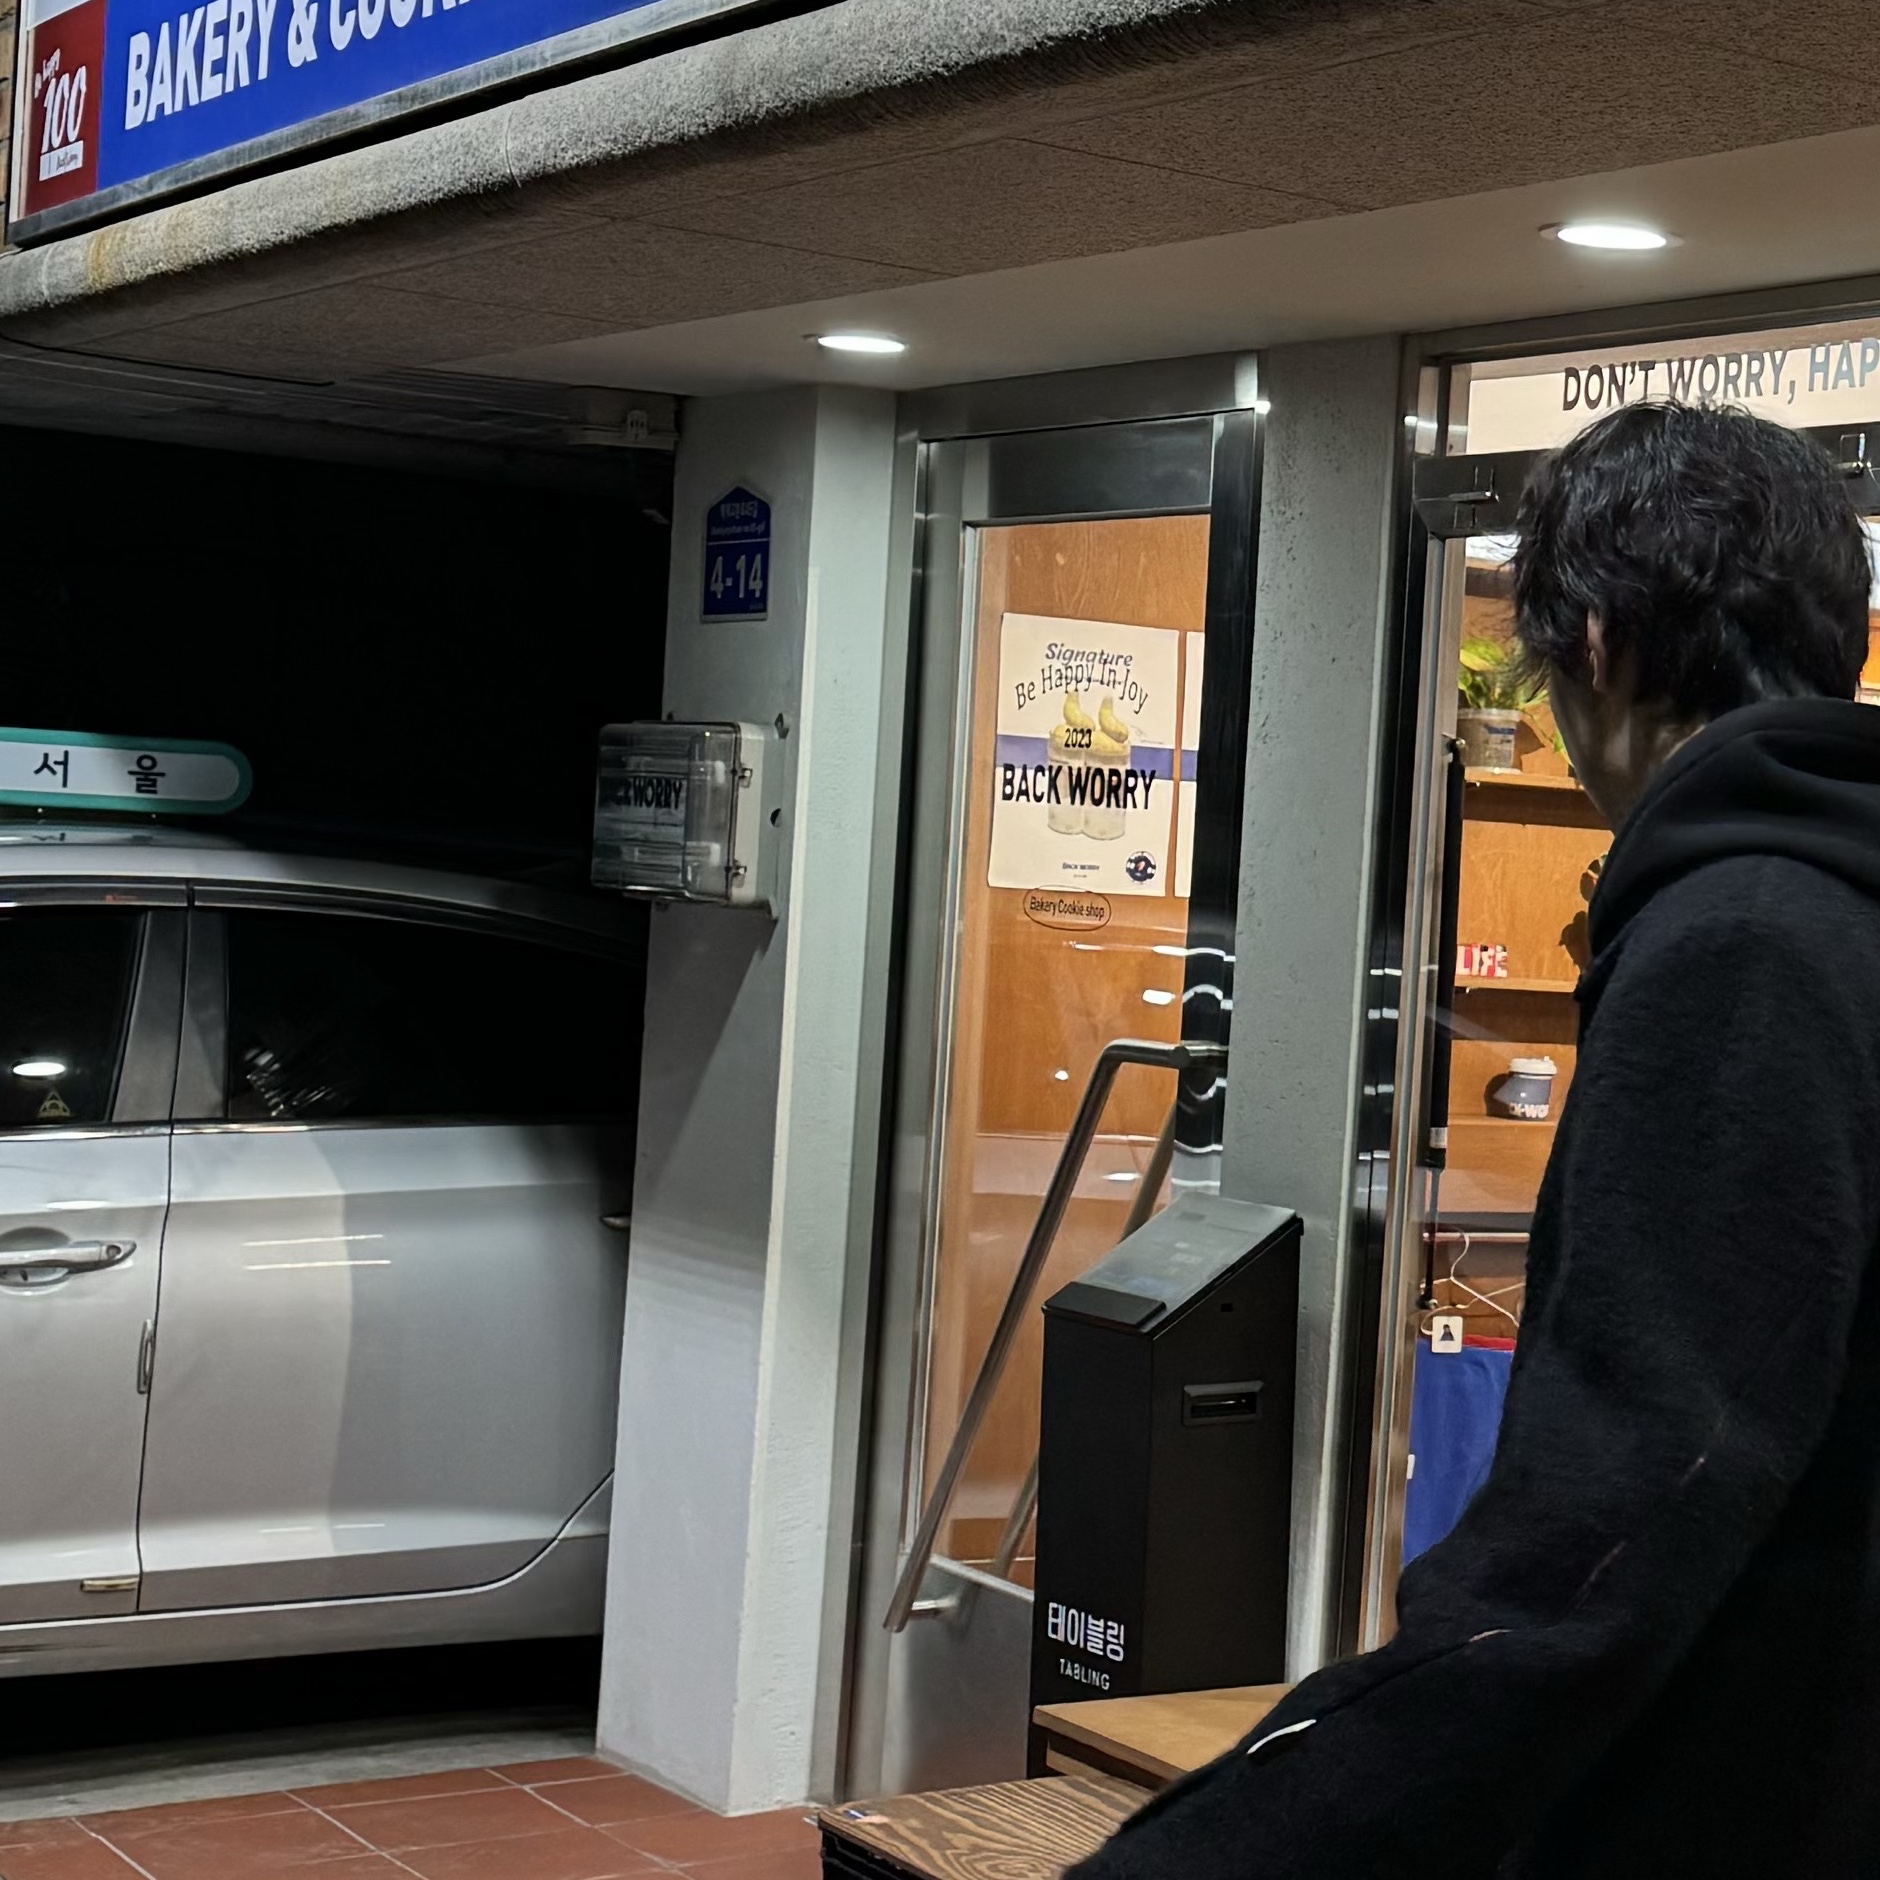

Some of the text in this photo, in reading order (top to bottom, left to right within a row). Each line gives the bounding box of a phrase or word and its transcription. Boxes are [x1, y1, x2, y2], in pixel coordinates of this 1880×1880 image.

[125, 0, 275, 130] BAKERY
[287, 0, 319, 68] &
[1563, 359, 1656, 412] DON'T
[1666, 349, 1797, 406] WORRY,
[710, 553, 763, 599] 4-14
[1045, 642, 1133, 667] Signature
[1015, 681, 1036, 710] Be
[1064, 727, 1092, 749] 2023
[33, 750, 166, 795] 서울
[1001, 763, 1156, 811] BACK WORRY
[1058, 899, 1085, 917] Cookie
[1085, 902, 1105, 921] shop
[1456, 944, 1508, 978] LIFE
[1047, 1601, 1125, 1662] 테이블링
[1059, 1658, 1110, 1691] TABLING
